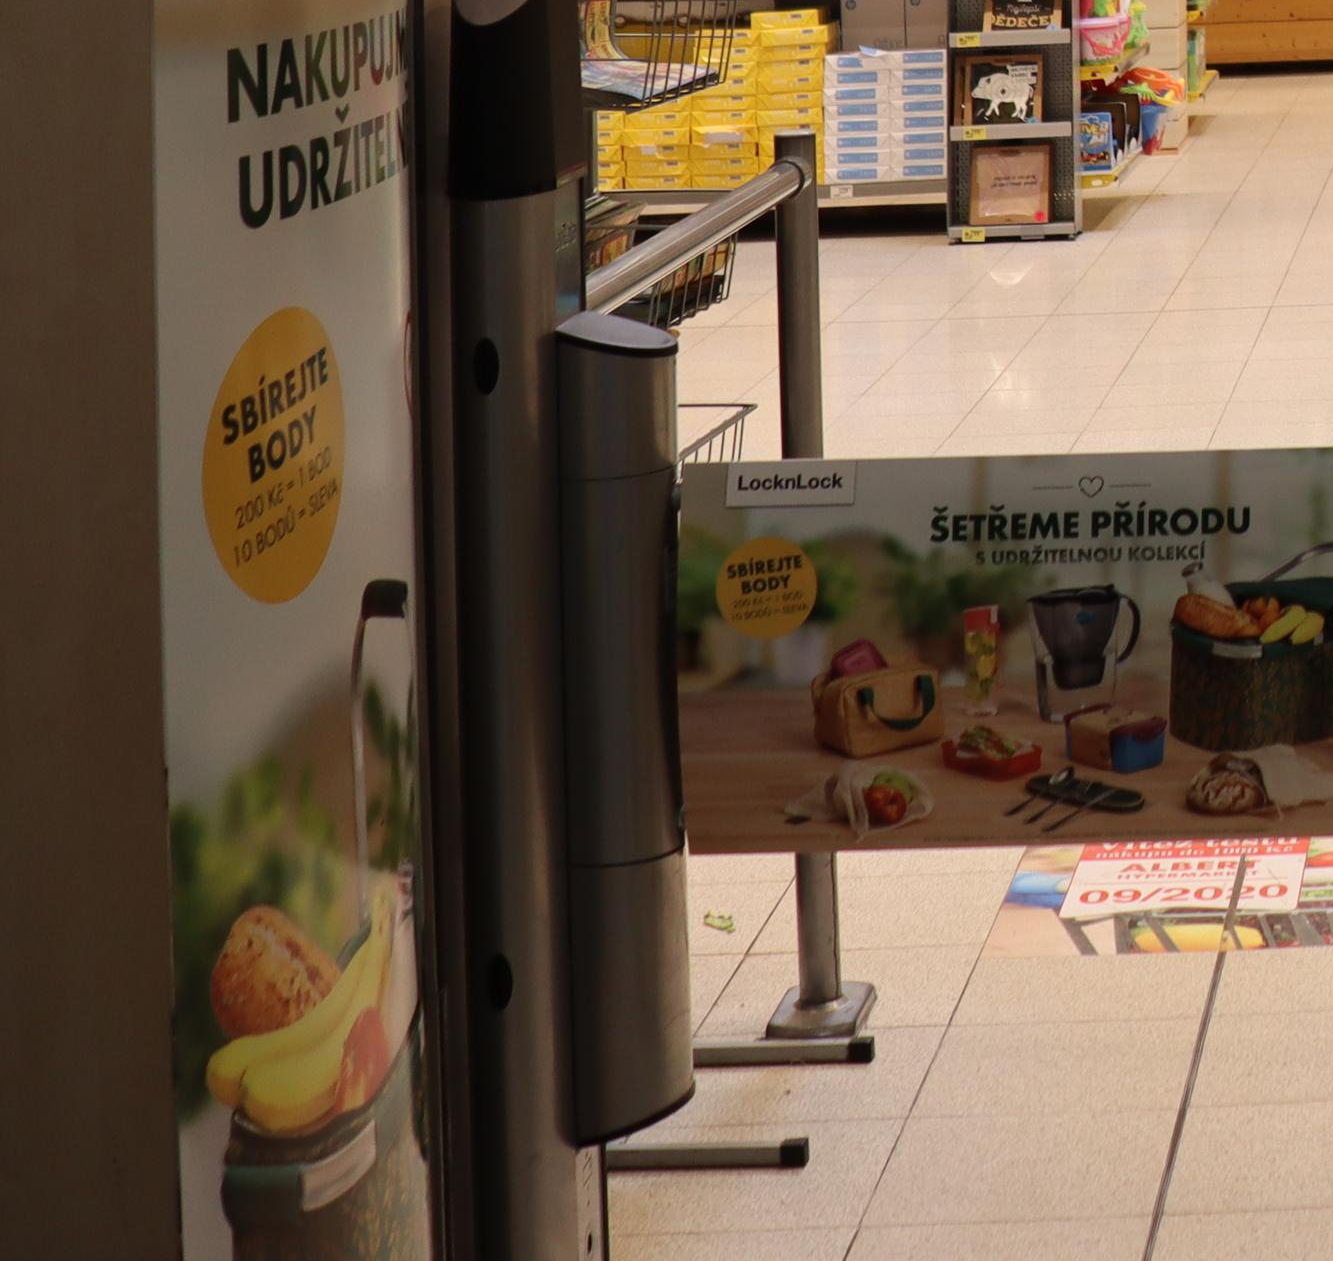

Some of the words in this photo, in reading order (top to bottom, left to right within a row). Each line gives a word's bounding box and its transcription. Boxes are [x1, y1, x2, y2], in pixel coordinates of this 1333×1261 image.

[222, 347, 328, 446] SBÍREJTE
[248, 404, 317, 483] BODY
[738, 473, 843, 491] LocknLock
[930, 505, 1080, 541] ŠETŘEME
[1091, 500, 1250, 537] PŘÍRODU
[975, 550, 985, 565] S
[991, 543, 1122, 565] UDRŽITELNOU
[1128, 540, 1206, 561] KOLEKCÍ
[727, 554, 803, 579] SBÍREJTE
[740, 575, 791, 595] BODY
[1120, 859, 1263, 873] ALBERT
[1079, 883, 1289, 905] 09/2020
